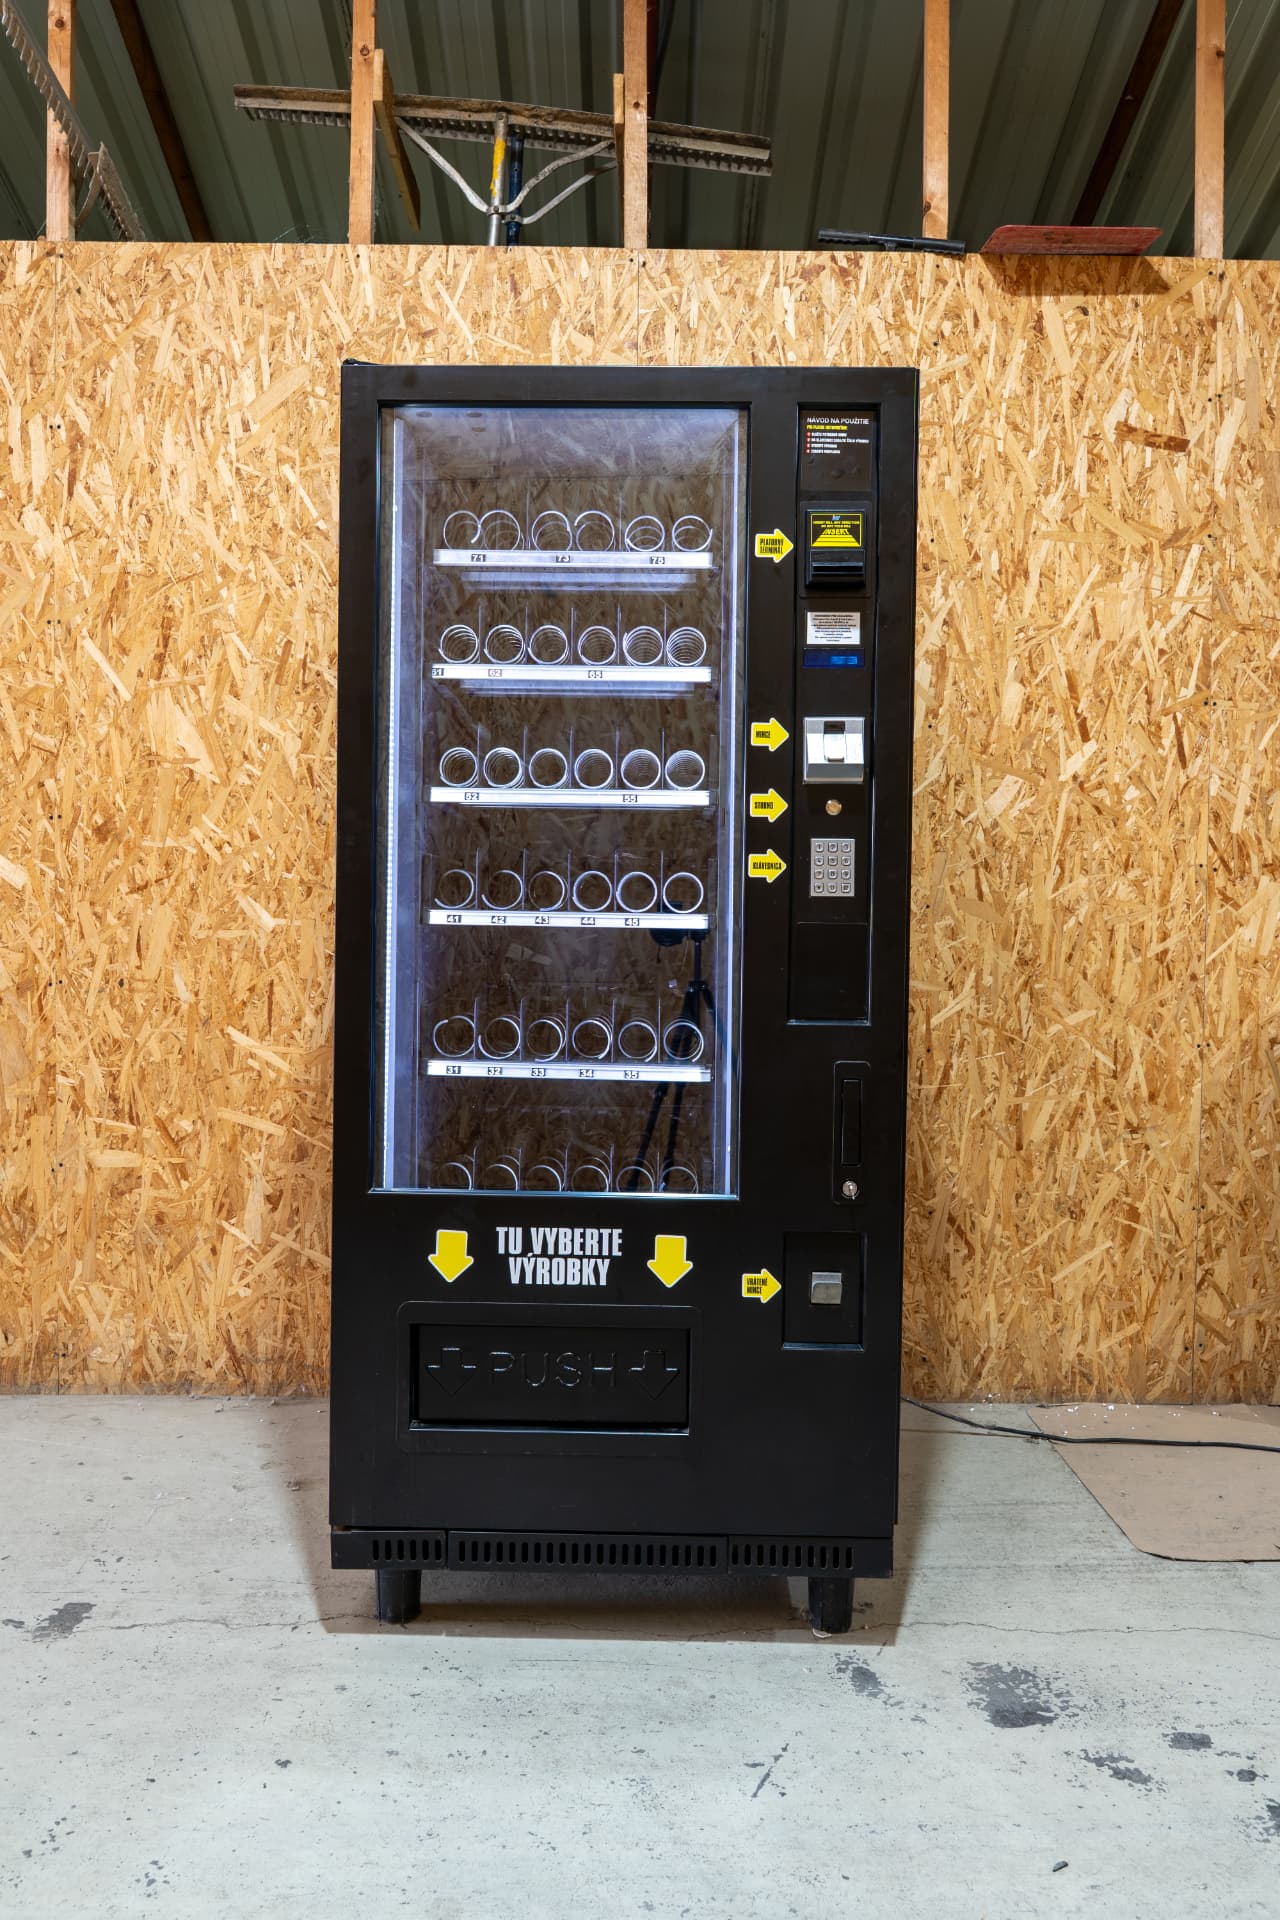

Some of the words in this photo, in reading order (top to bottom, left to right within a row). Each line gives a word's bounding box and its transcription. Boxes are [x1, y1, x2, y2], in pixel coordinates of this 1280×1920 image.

[822, 528, 850, 536] INSERT
[472, 554, 485, 562] 71
[556, 555, 570, 563] 73
[488, 669, 502, 677] 62
[447, 915, 461, 923] 41
[491, 916, 506, 924] 42
[535, 916, 549, 924] 43
[581, 917, 595, 925] 44
[625, 918, 639, 926] 45
[447, 1066, 461, 1074] 31
[488, 1067, 502, 1075] 32
[531, 1068, 545, 1076] 33
[580, 1069, 594, 1077] 34
[496, 1227, 522, 1254] TU
[531, 1227, 622, 1256] VYBERTE
[509, 1253, 610, 1285] VÝROBKY
[489, 1351, 616, 1387] PUSH
